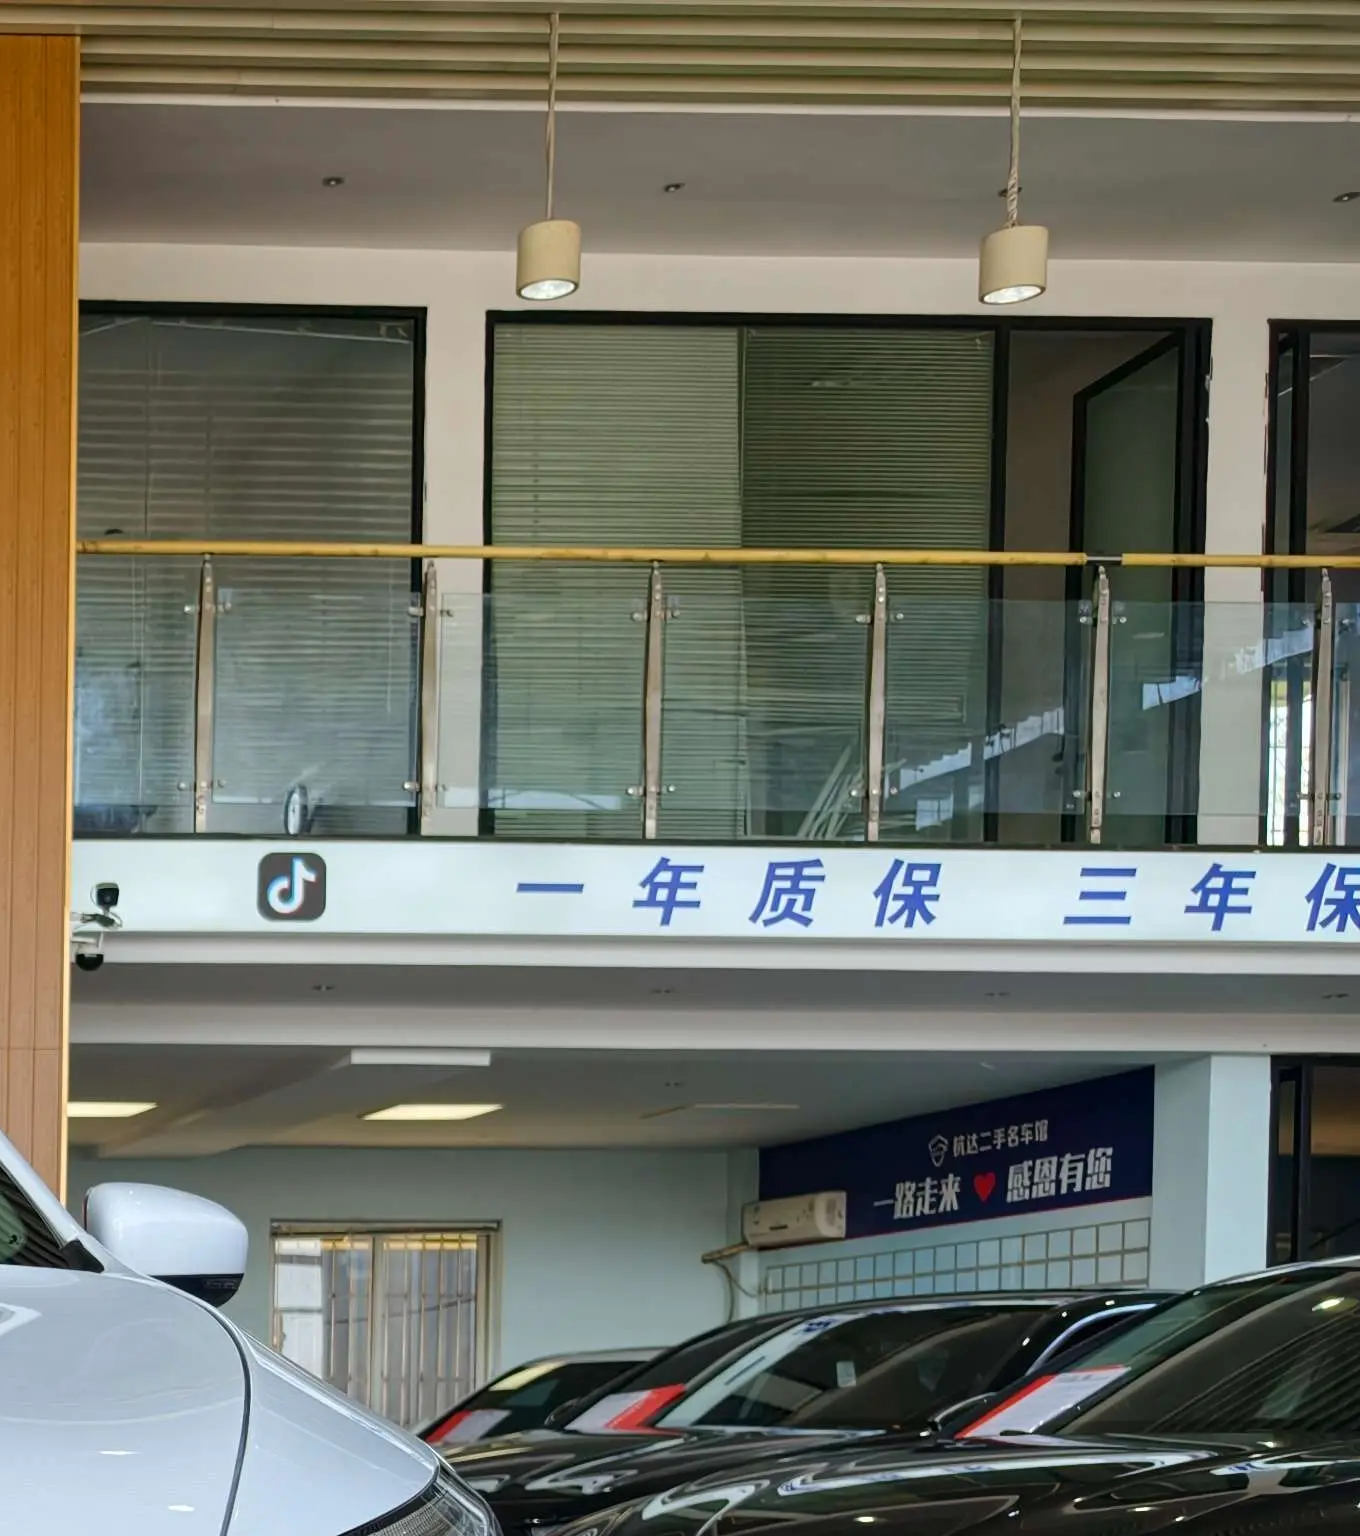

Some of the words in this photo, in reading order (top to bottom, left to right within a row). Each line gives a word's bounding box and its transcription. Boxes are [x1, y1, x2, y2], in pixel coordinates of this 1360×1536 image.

[516, 856, 944, 929] 一年质保
[1063, 862, 1360, 933] 三年保
[873, 1173, 961, 1220] 一路走来
[1006, 1146, 1114, 1204] 感恩有您
